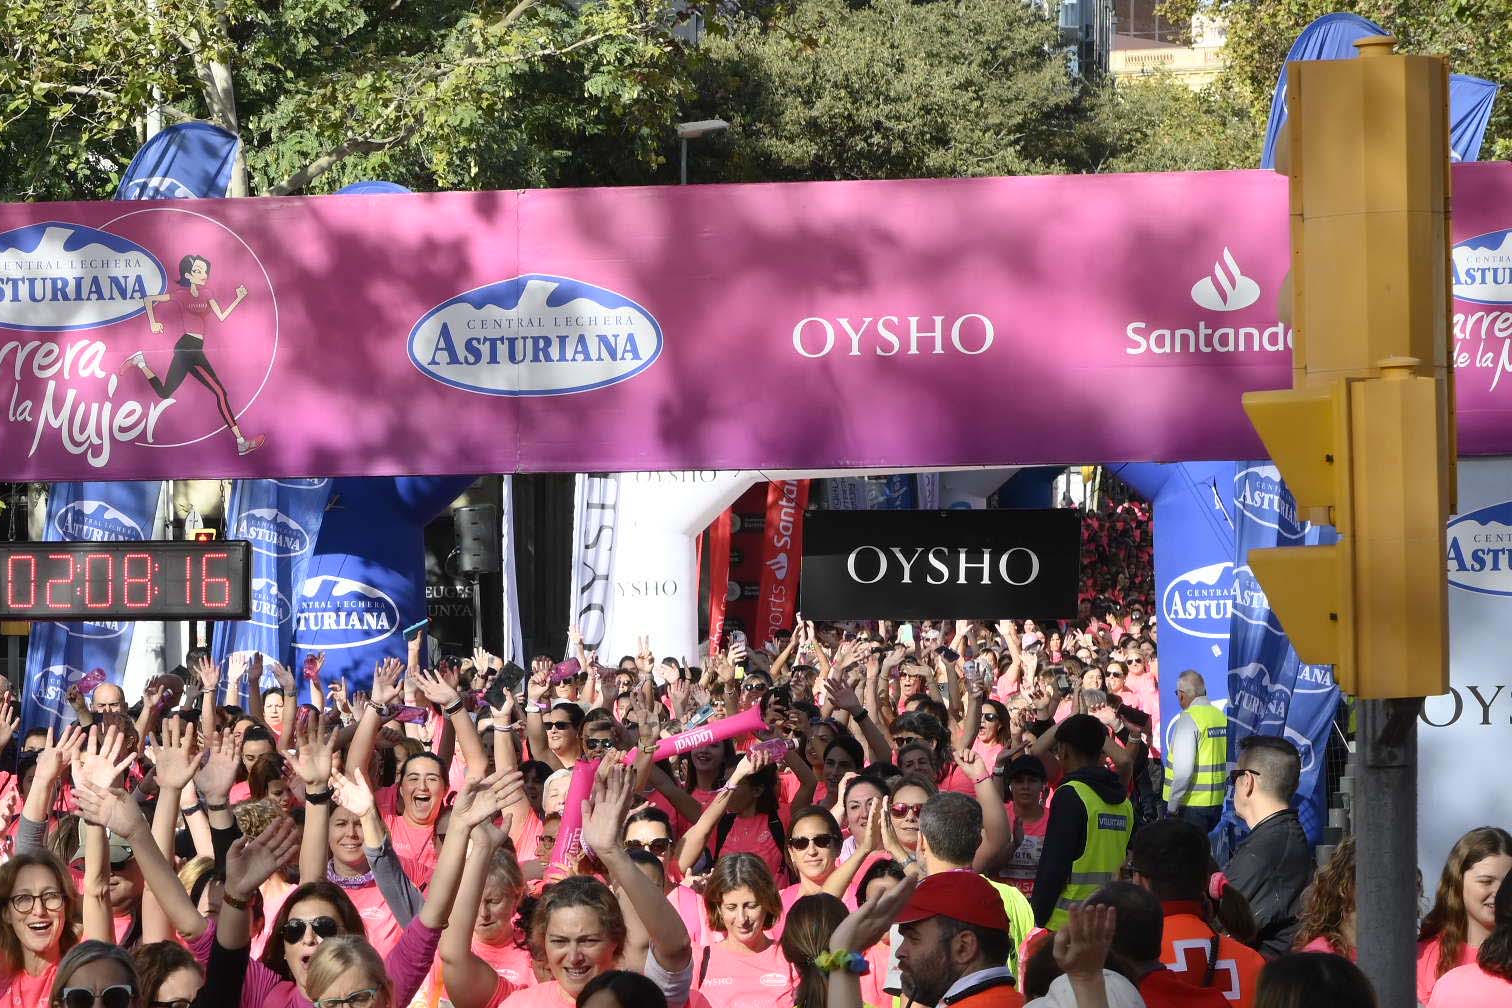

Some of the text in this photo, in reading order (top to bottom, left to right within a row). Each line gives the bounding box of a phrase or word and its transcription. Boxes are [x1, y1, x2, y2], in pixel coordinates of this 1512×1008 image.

[69, 258, 143, 270] LECHERA
[466, 315, 635, 330] CENTRAL LECHERA
[791, 313, 995, 358] OYSHO
[428, 322, 642, 367] ASTURIANA
[1476, 340, 1494, 368] la
[8, 383, 32, 423] la
[28, 374, 177, 468] Mujer
[7, 553, 230, 608] 02:08:16
[847, 545, 1040, 586] OYSHO
[336, 600, 387, 609] LECHERA
